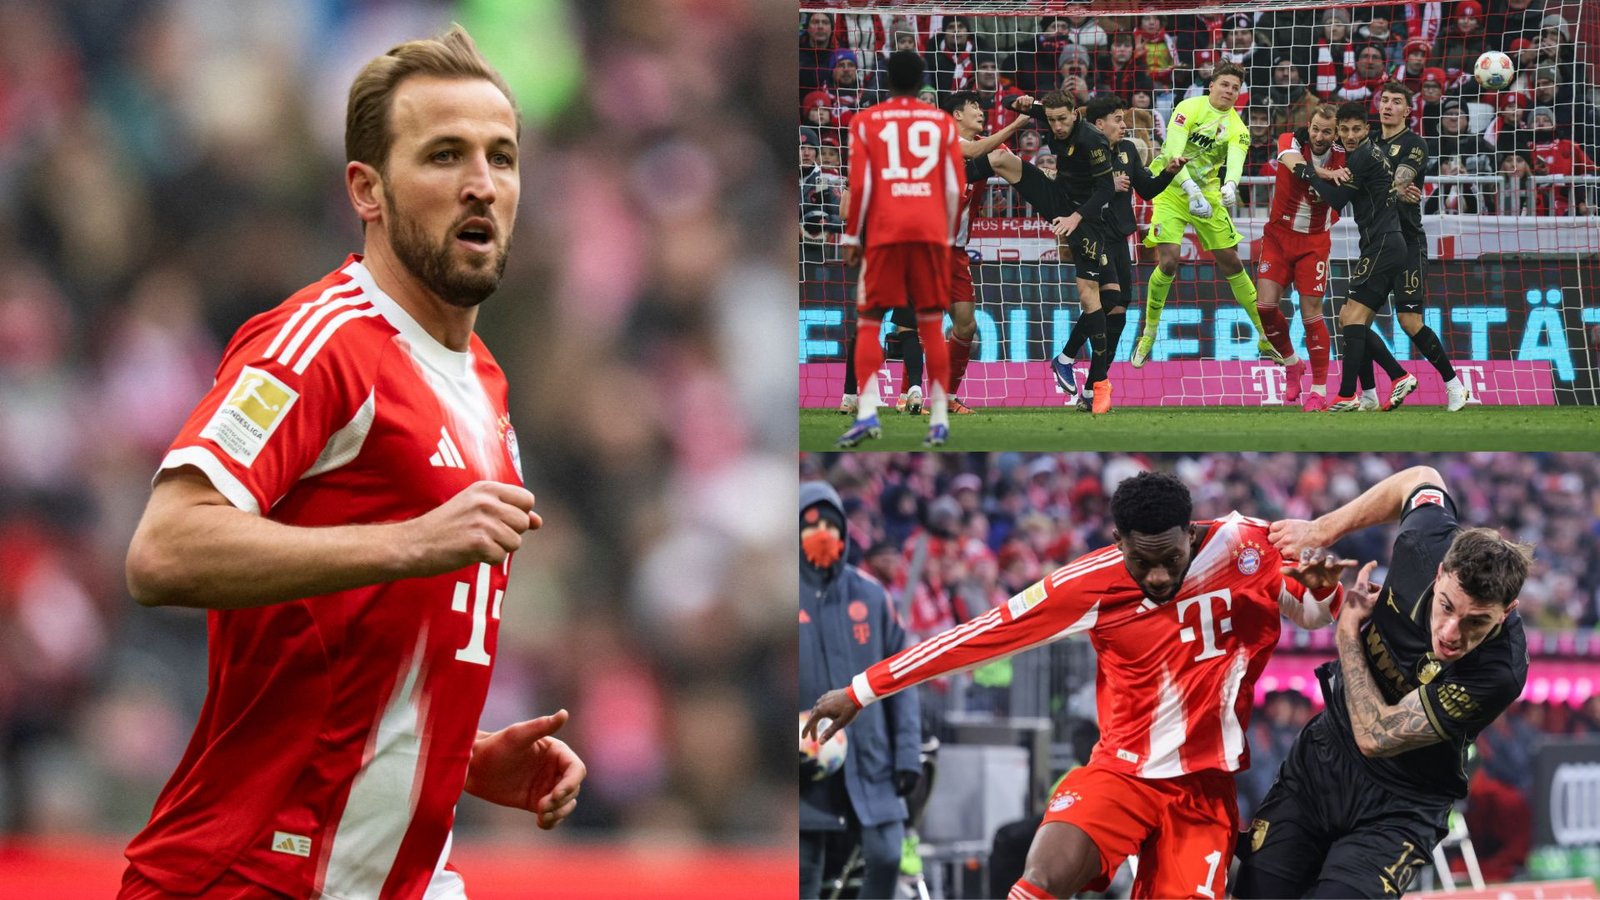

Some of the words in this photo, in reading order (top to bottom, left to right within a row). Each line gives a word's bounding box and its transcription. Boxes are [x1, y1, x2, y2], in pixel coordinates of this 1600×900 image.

[878, 120, 941, 179] 19
[1002, 220, 1020, 231] FC
[1225, 217, 1233, 233] 1
[1081, 237, 1097, 260] 34
[1315, 261, 1325, 281] 9
[1403, 269, 1420, 288] 16
[1176, 588, 1233, 662] T
[1196, 850, 1228, 899] 1
[1384, 841, 1425, 891] 16
